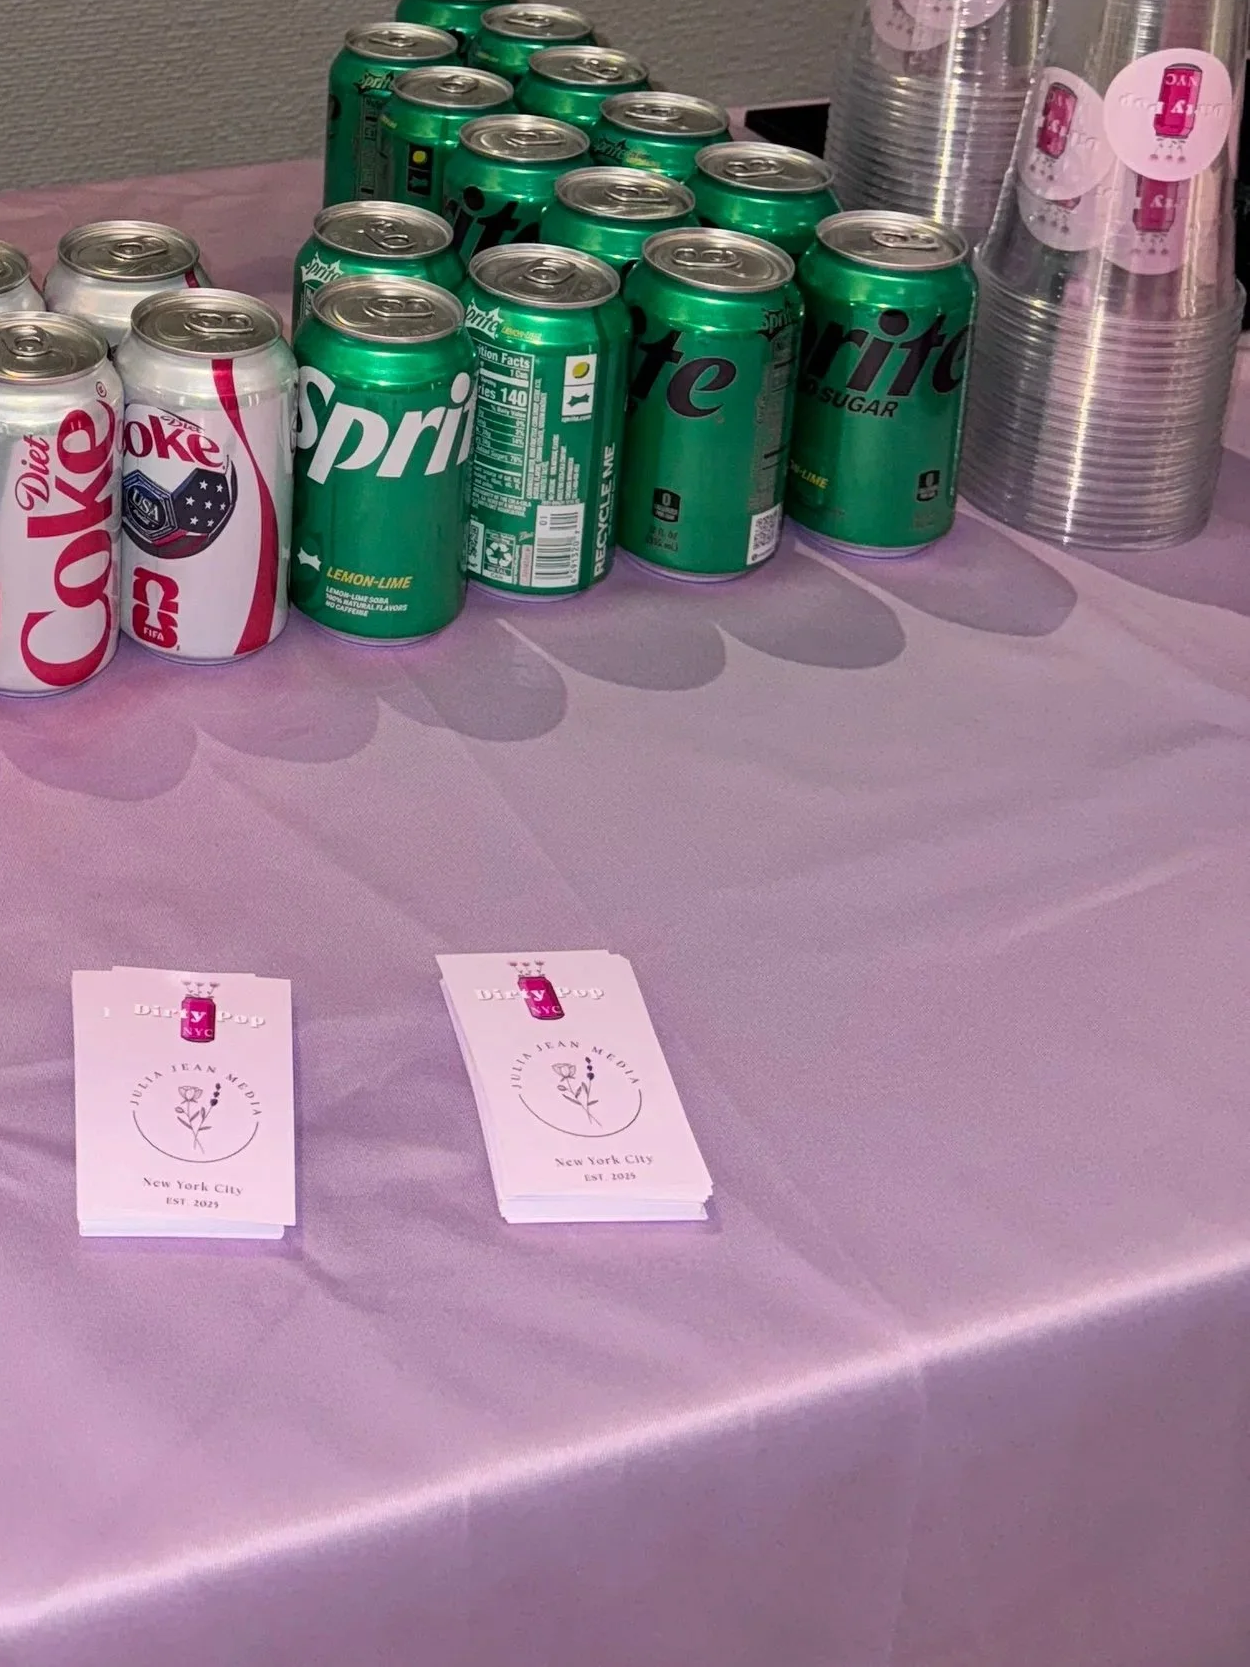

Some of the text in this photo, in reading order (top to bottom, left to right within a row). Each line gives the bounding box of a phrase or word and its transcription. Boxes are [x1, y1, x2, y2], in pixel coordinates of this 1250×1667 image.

[501, 352, 530, 369] Facts
[500, 387, 528, 407] 140
[822, 387, 899, 418] SUGAR
[122, 414, 224, 468] oke
[14, 433, 52, 513] Diet
[133, 487, 159, 522] USA
[593, 442, 616, 577] RECYCLE ME
[20, 399, 116, 687] Coke
[326, 566, 413, 589] LEMON-LIME
[326, 586, 368, 602] LEMON-LIME
[335, 603, 369, 617] CAFFEINE
[343, 597, 376, 611] NATURAL
[376, 603, 408, 612] FLAVORS
[143, 627, 164, 641] FIFA
[474, 986, 605, 1002] Dirty Pop
[134, 1003, 266, 1028] Dirty Pop
[531, 1005, 563, 1015] NYC
[183, 1027, 214, 1038] NYC
[511, 1040, 640, 1089] JULIA JEAN MEDIA
[130, 1063, 262, 1116] JULIA JEAN MEDIA
[554, 1154, 654, 1168] New York City
[143, 1177, 243, 1197] New York City
